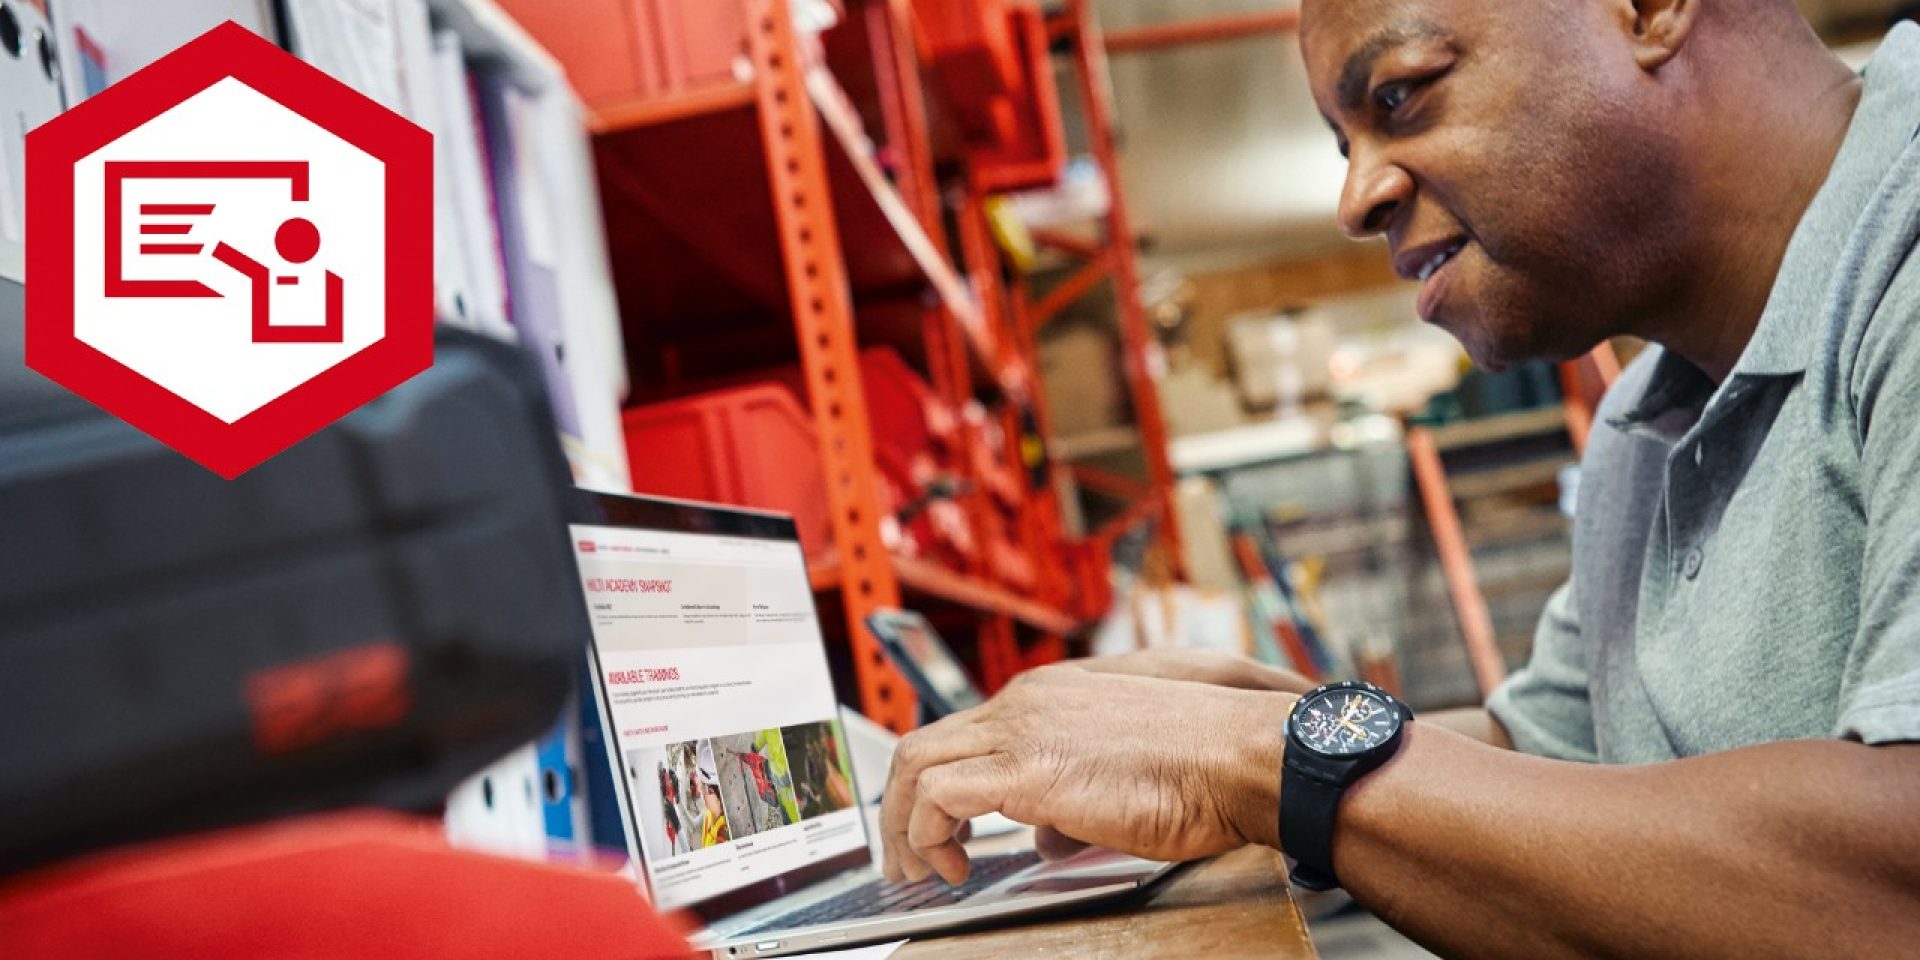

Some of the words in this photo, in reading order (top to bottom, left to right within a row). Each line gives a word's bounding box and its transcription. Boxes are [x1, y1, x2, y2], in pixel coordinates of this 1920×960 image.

[605, 578, 638, 593] ACADEMY
[639, 579, 672, 593] SNAPSHOT
[608, 669, 645, 685] AVAILABLE
